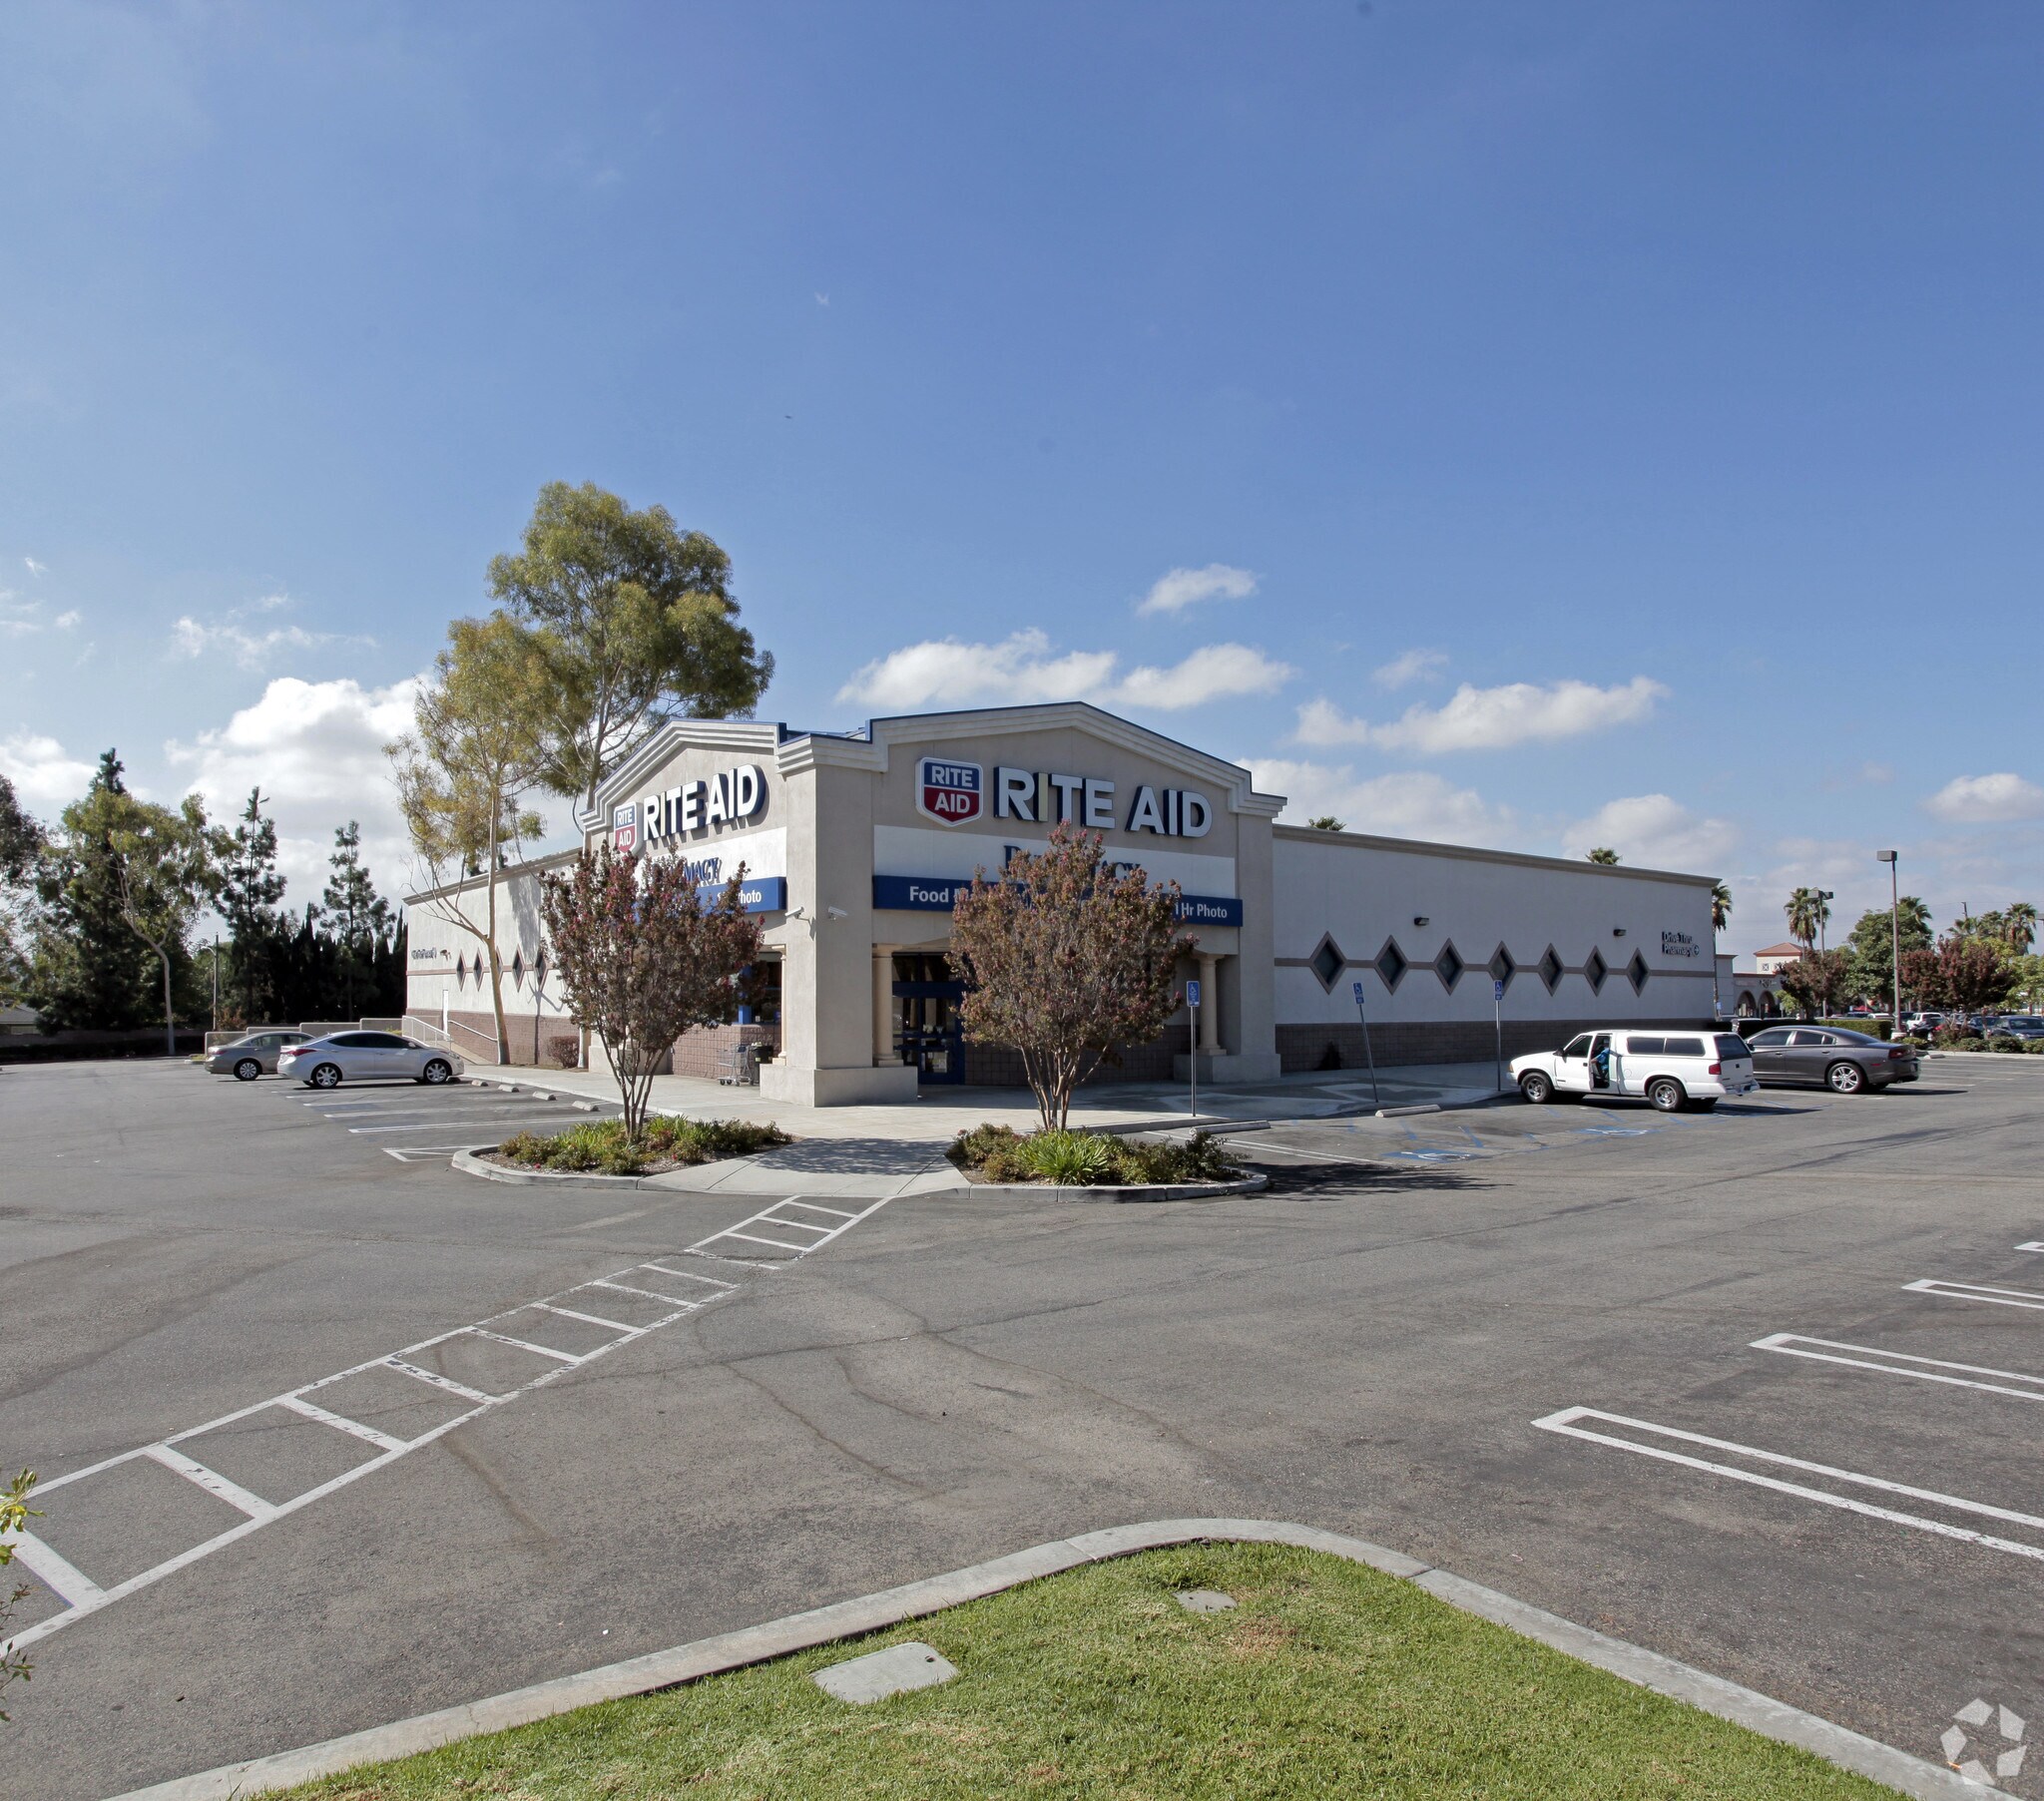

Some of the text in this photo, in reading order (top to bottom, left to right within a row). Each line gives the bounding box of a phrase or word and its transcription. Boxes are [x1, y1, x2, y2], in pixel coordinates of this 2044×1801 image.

[932, 765, 973, 788] RITE
[644, 764, 759, 841] RITE AID
[934, 792, 971, 814] AID
[998, 766, 1214, 838] RITE AID
[617, 808, 634, 824] RITE
[618, 829, 633, 847] AID
[737, 889, 763, 905] hoto
[909, 886, 949, 903] Food
[1182, 902, 1195, 916] Hr
[1197, 903, 1229, 919] Photo
